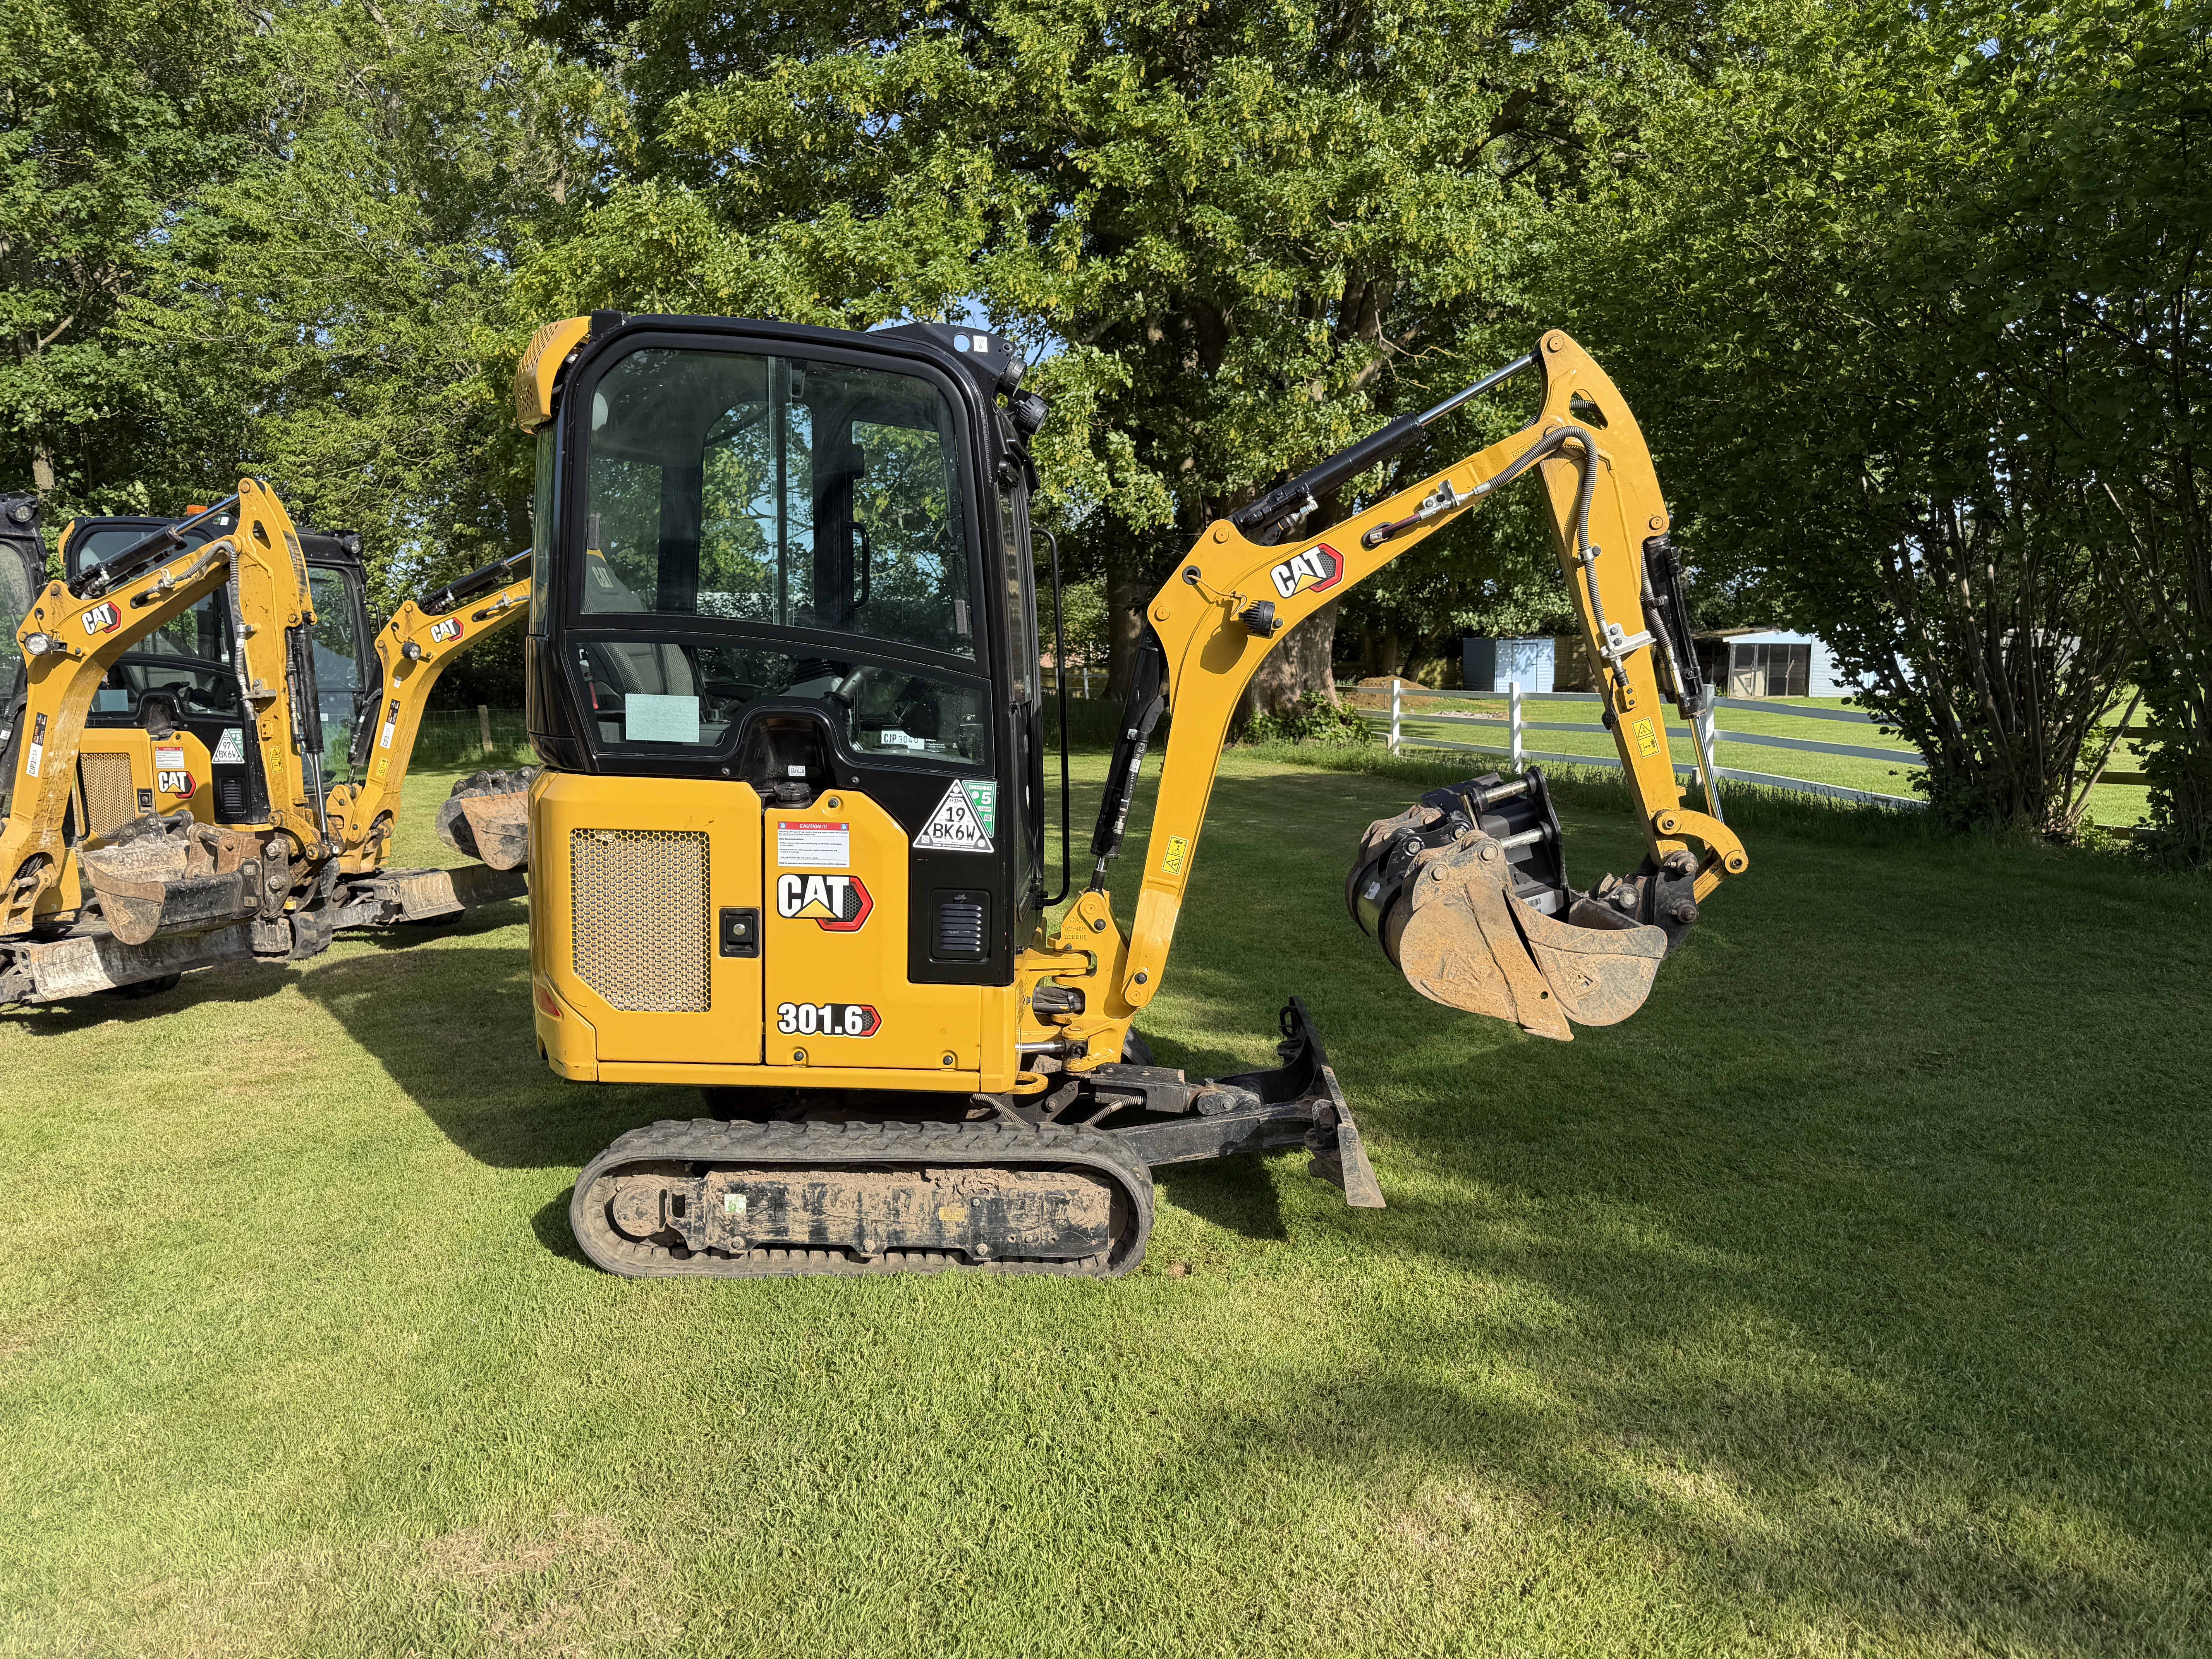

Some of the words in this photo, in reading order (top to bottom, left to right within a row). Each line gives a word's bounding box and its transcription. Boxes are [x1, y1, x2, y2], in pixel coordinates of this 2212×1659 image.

[592, 566, 614, 588] CAT
[1271, 546, 1327, 598] CAT
[81, 603, 113, 634] CAT
[430, 618, 456, 642] CAT
[29, 749, 38, 775] CJP3037
[218, 750, 236, 758] BK6W
[158, 771, 187, 792] CAT
[981, 792, 992, 805] 5
[945, 807, 965, 823] 19
[933, 823, 975, 841] BK6W
[778, 874, 849, 918] CAT
[778, 1003, 863, 1035] 301.6
